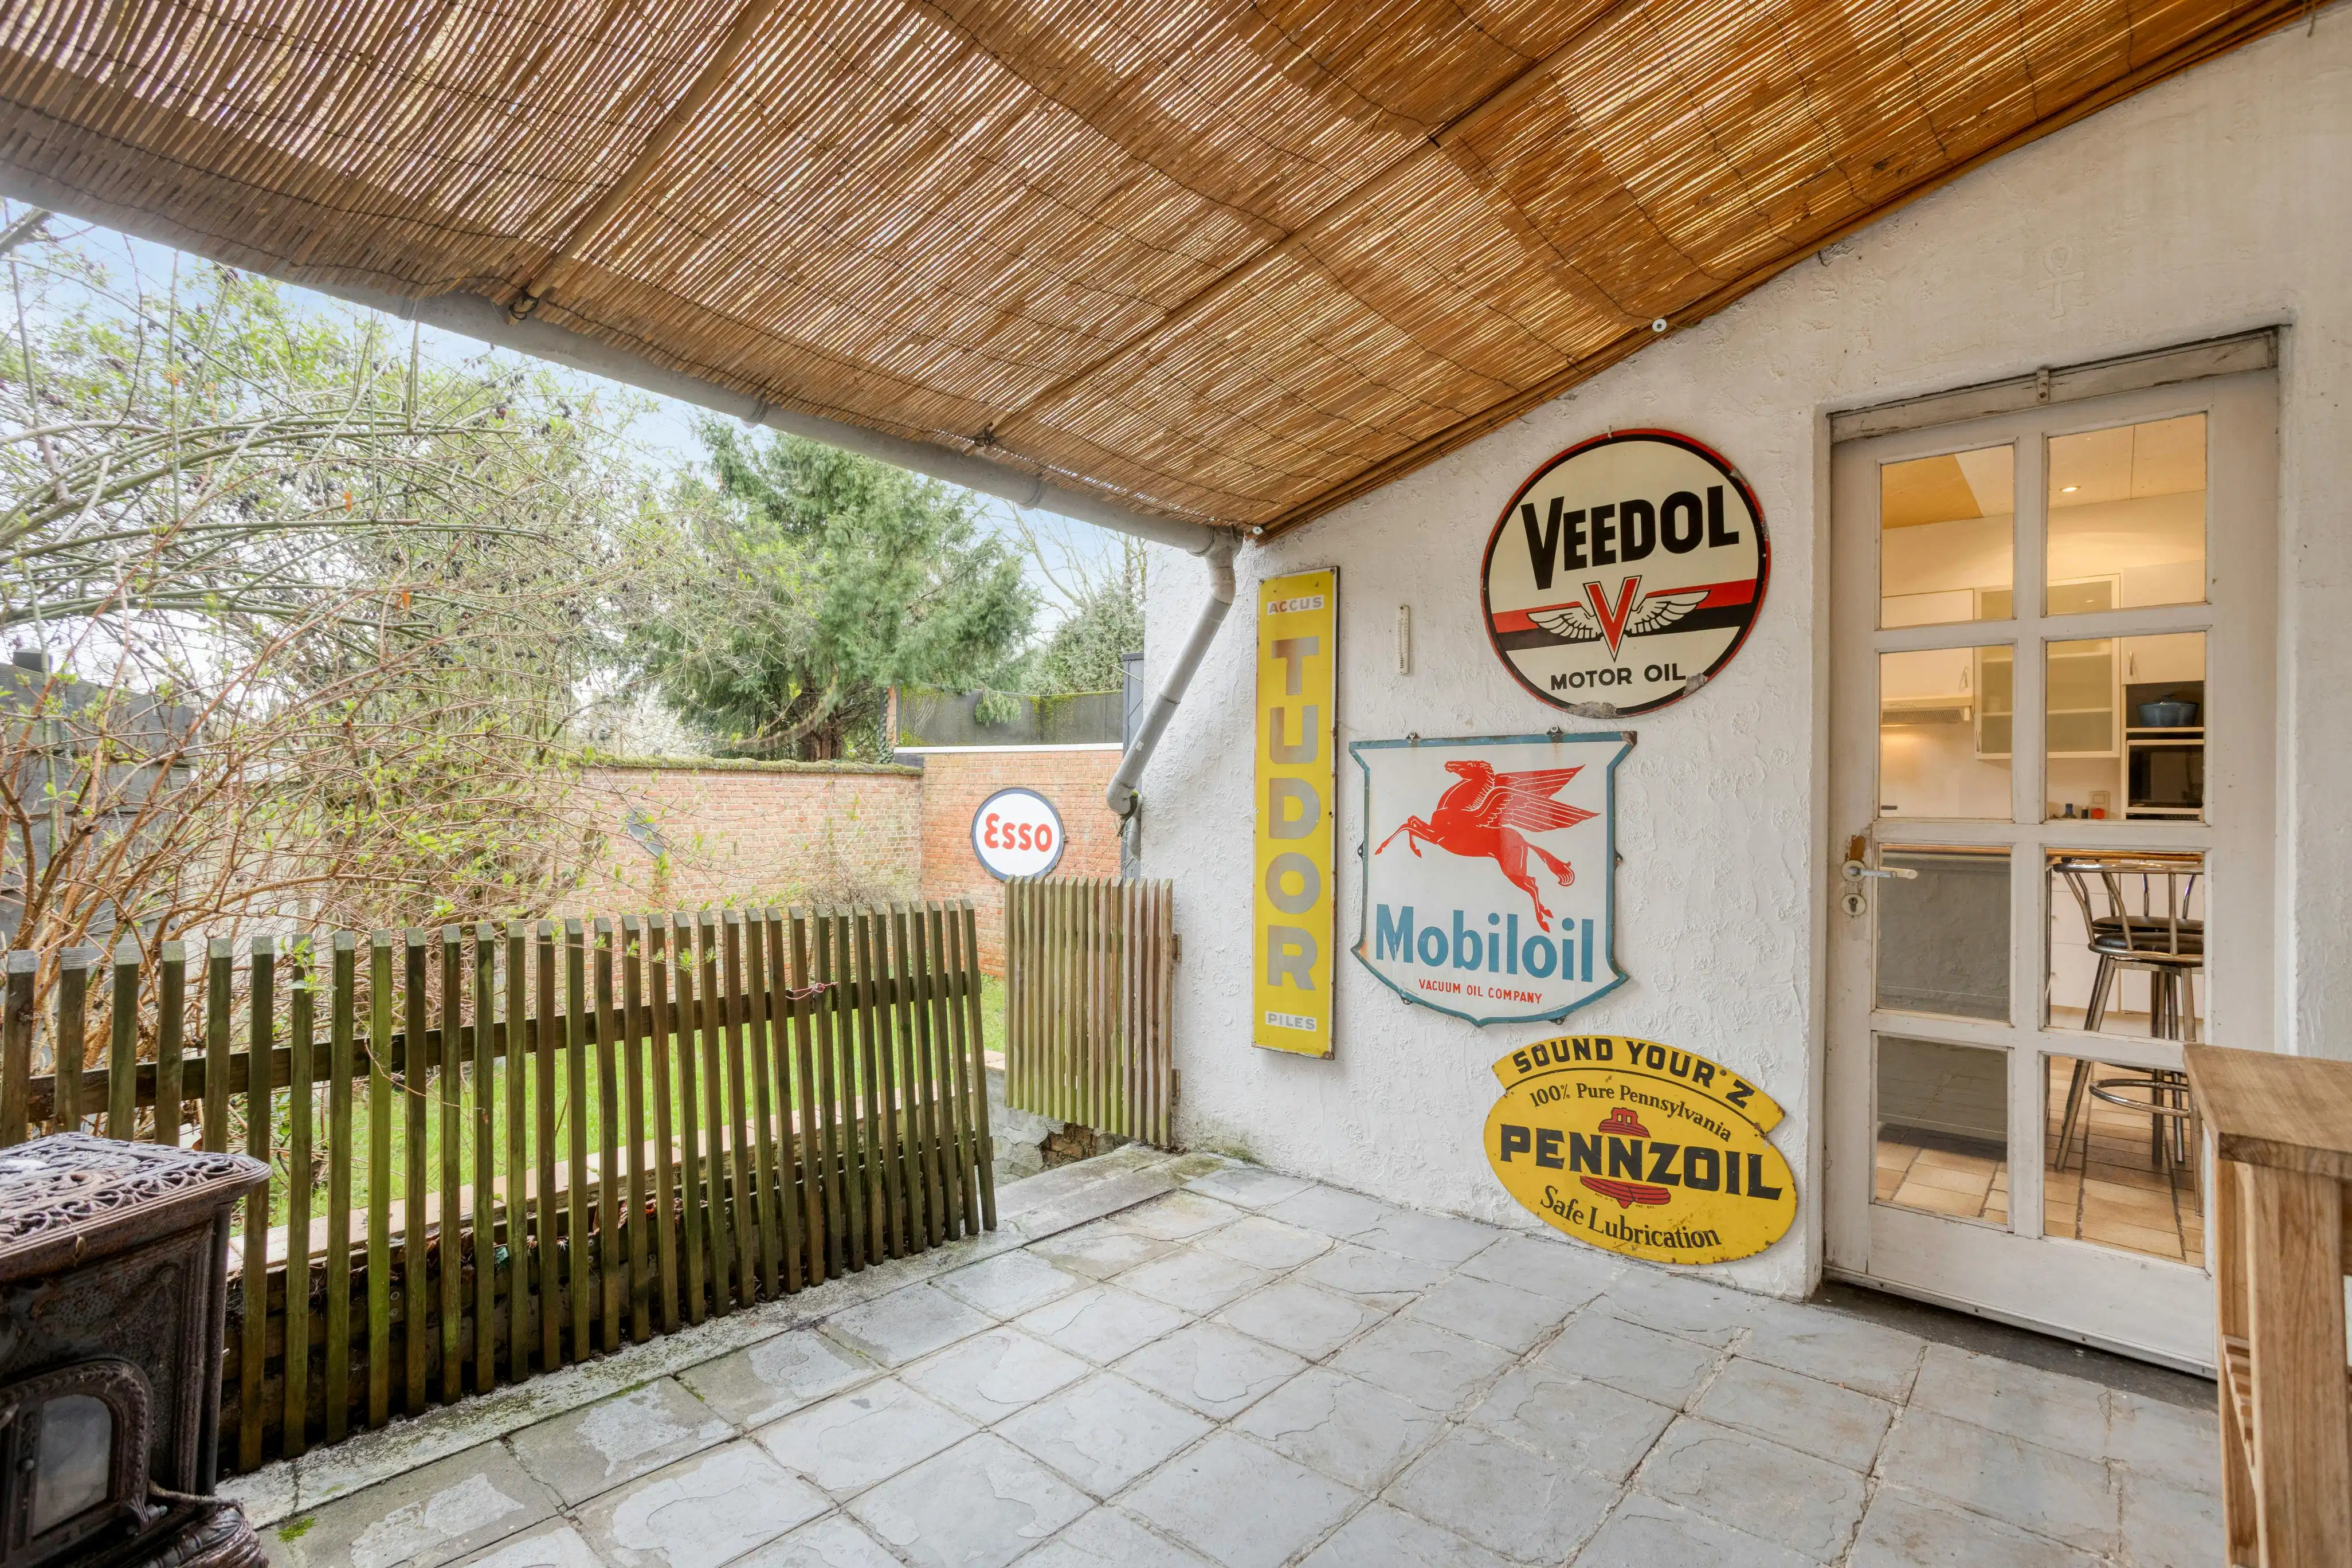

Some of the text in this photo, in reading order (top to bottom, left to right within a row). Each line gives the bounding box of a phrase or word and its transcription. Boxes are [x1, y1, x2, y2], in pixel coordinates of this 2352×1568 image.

[1520, 485, 1739, 590] VEEDOL
[1269, 597, 1322, 614] ACCUS
[1550, 663, 1686, 690] MOTOR OIL
[1265, 636, 1321, 991] TUDOR
[1376, 903, 1594, 982] Mobiloil
[1268, 1013, 1315, 1030] PILES
[1418, 978, 1461, 994] VACUUM
[1467, 985, 1483, 997] OIL
[1488, 987, 1542, 1004] COMPANY
[1512, 1038, 1755, 1109] SOUND YOUR Z
[1530, 1083, 1731, 1143] 100% Pure Pennsylvania
[1500, 1124, 1783, 1201] PENNZOIL
[1540, 1185, 1722, 1248] Safe Lubrication
